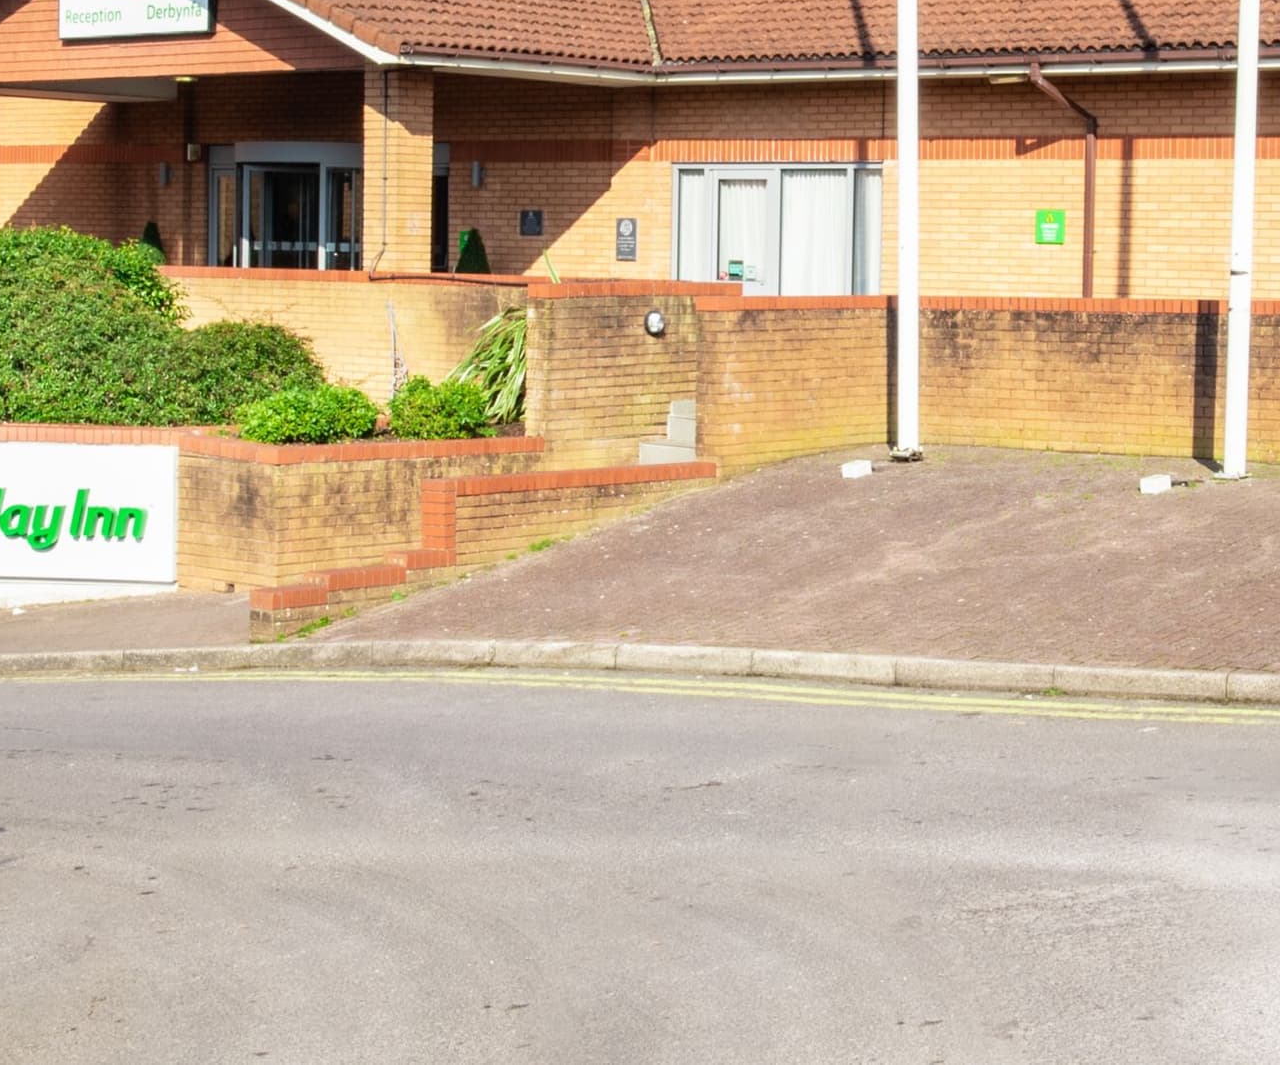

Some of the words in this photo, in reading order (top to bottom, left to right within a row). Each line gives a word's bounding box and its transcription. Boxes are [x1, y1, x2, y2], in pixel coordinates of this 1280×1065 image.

[65, 9, 122, 26] Reception
[146, 1, 202, 22] Derbynfa
[70, 488, 147, 542] Inn
